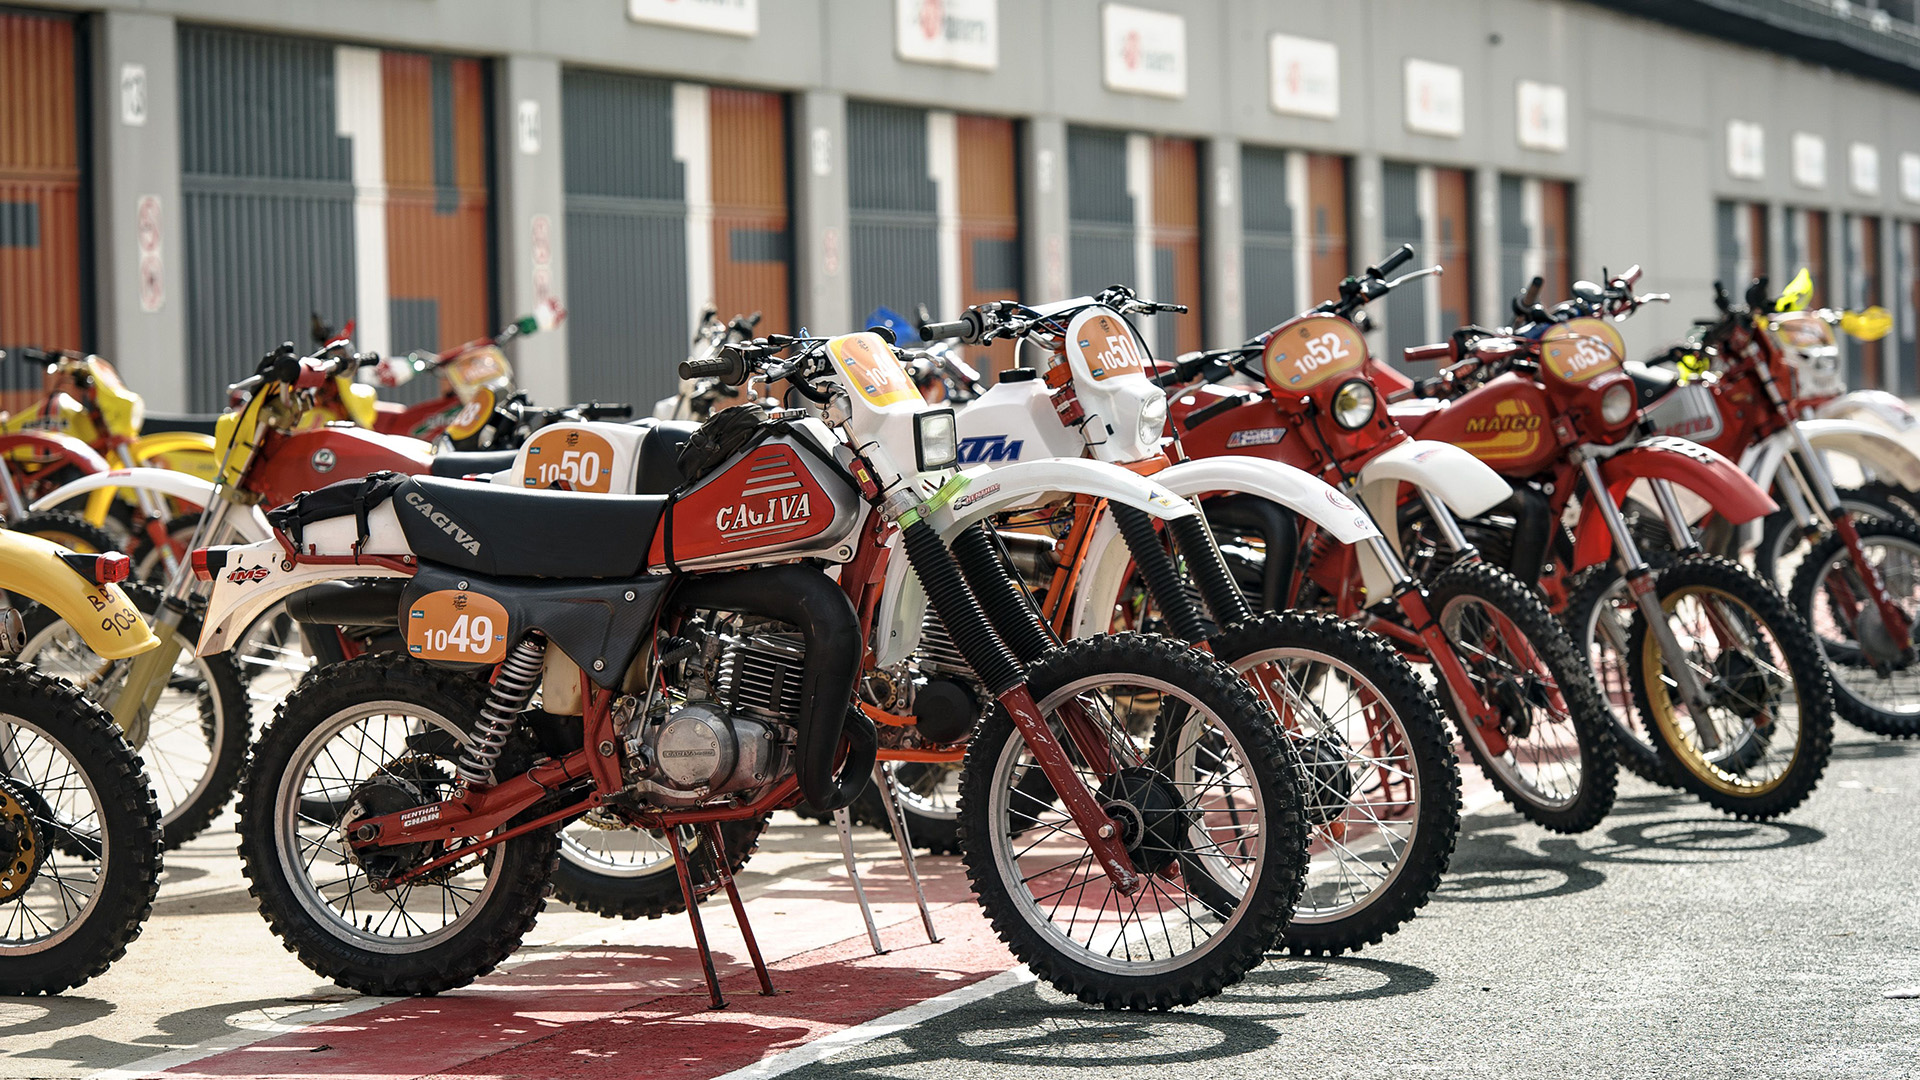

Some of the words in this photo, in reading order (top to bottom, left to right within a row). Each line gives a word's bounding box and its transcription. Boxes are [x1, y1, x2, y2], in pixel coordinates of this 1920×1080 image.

[1097, 335, 1139, 370] 1050
[1294, 332, 1350, 375] 1052
[1567, 335, 1612, 372] 1053
[1466, 415, 1541, 433] MAICO
[539, 450, 600, 487] 1050
[405, 492, 481, 556] CAGIVA
[228, 568, 268, 582] IMS
[424, 614, 493, 654] 1049
[400, 805, 441, 821] RENTHAL
[403, 812, 440, 827] CHAIN
